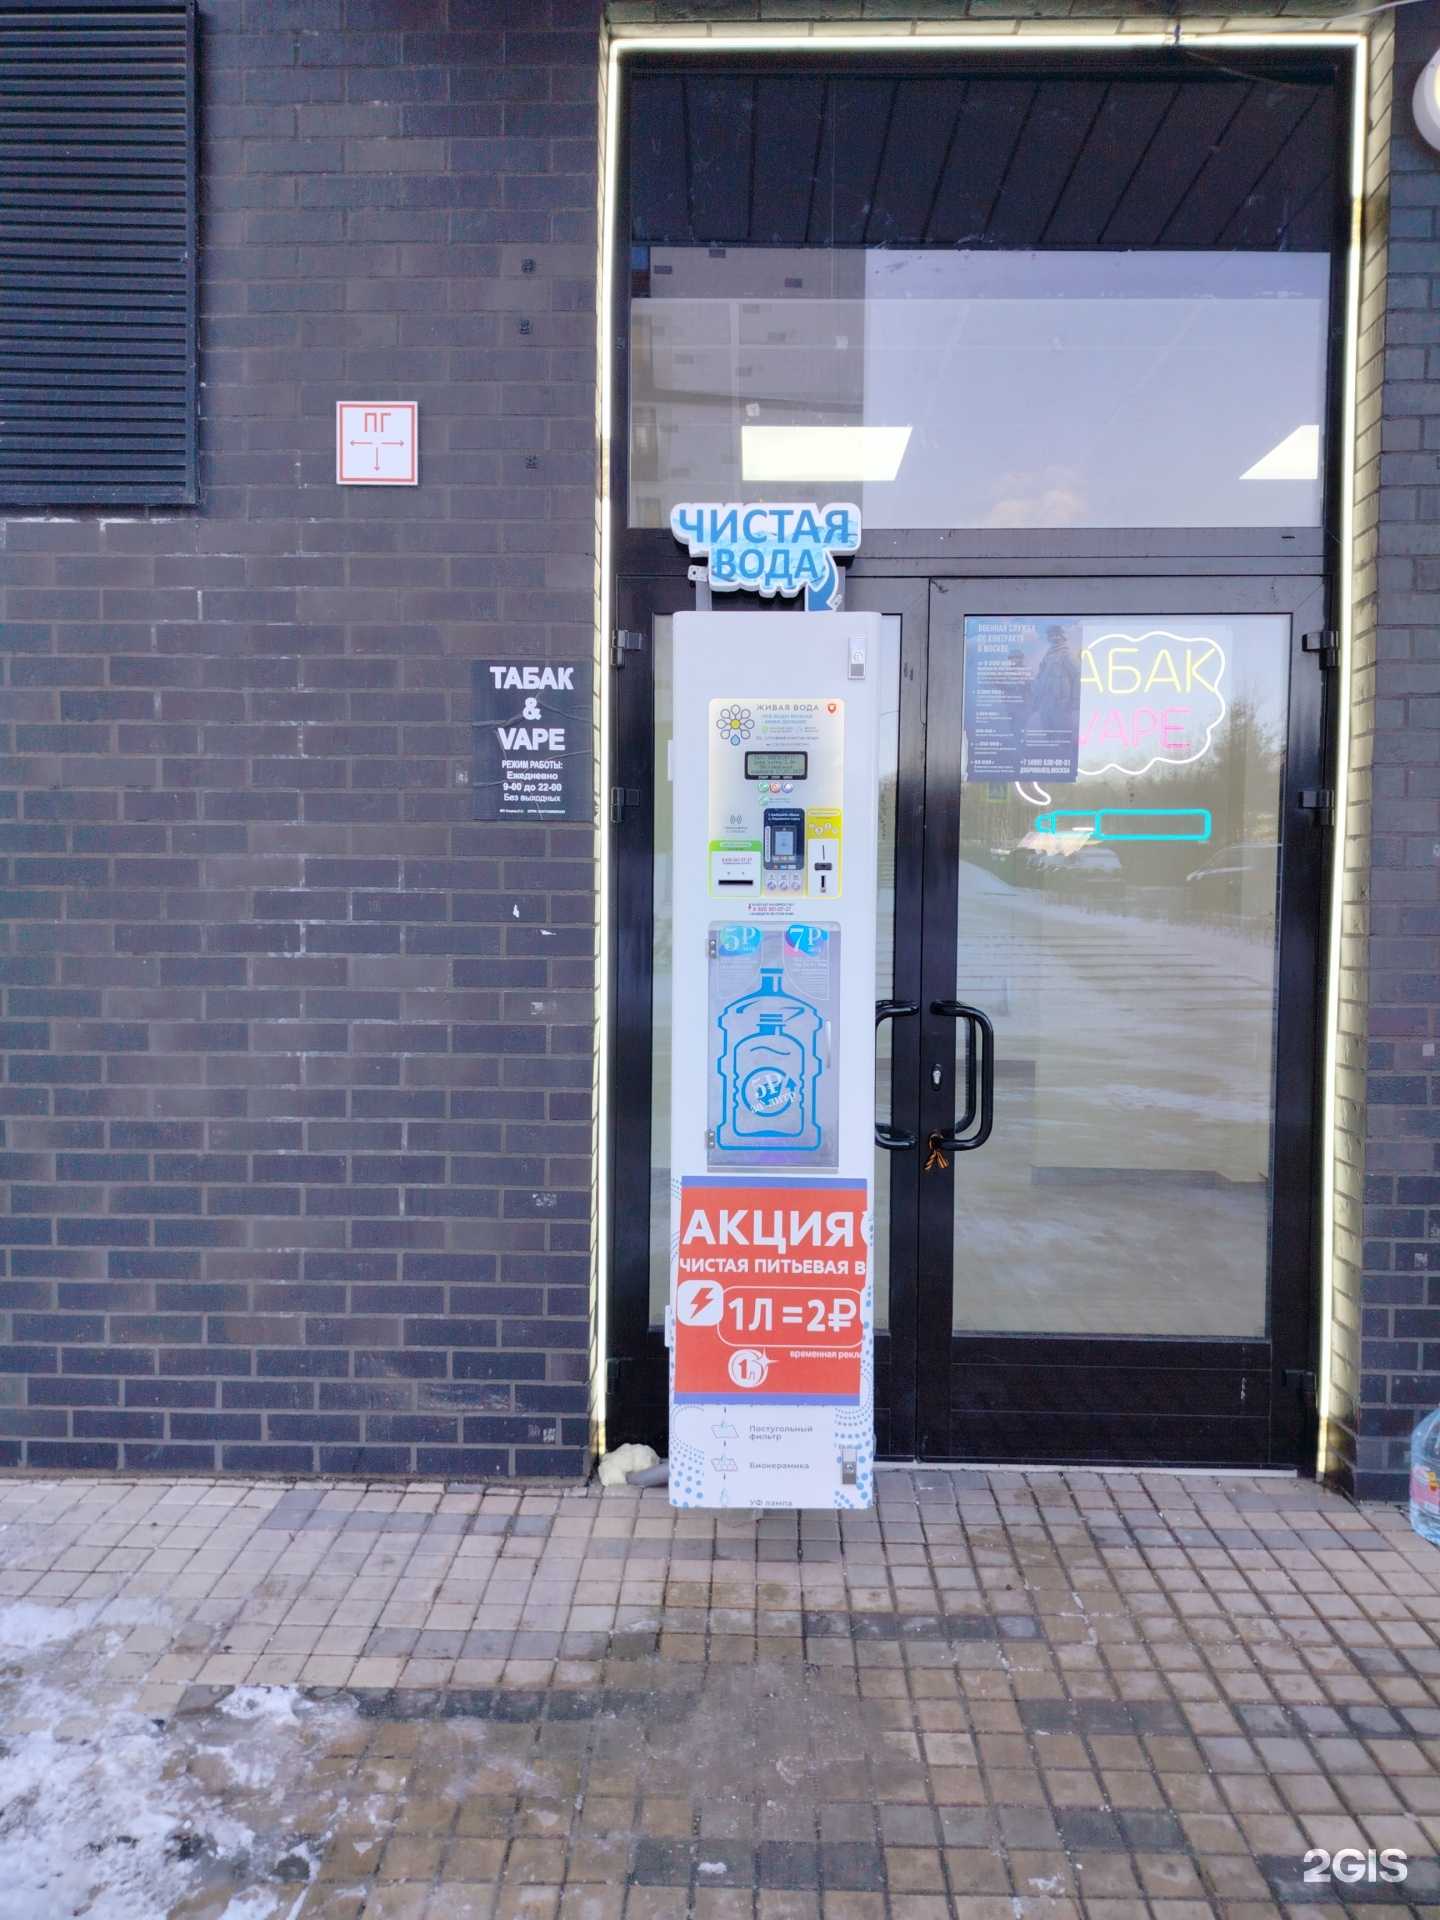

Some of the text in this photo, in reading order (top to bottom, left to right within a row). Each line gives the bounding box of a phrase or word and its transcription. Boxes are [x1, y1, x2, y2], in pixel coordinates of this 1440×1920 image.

[364, 412, 392, 432] ПГ
[679, 508, 849, 544] ЧИСТАЯ
[716, 548, 820, 586] ВОДА
[489, 666, 574, 690] ТАБАК
[522, 697, 542, 720] &
[497, 727, 566, 751] VAPE
[502, 760, 563, 769] РЕЖИМ РАБОТЫ:
[506, 771, 559, 781] Ежедневно
[502, 783, 522, 791] 9-00
[538, 783, 562, 791] 22-00
[504, 793, 561, 802] Без выходных
[682, 1209, 855, 1254] АКЦИЯ
[679, 1257, 749, 1273] ЧИСТАЯ
[754, 1258, 849, 1275] ПИТЬЕВАЯ
[789, 1350, 837, 1360] временная
[749, 1424, 813, 1434] Постугольный
[749, 1433, 782, 1441] фильтр
[749, 1462, 810, 1470] Биокерамика
